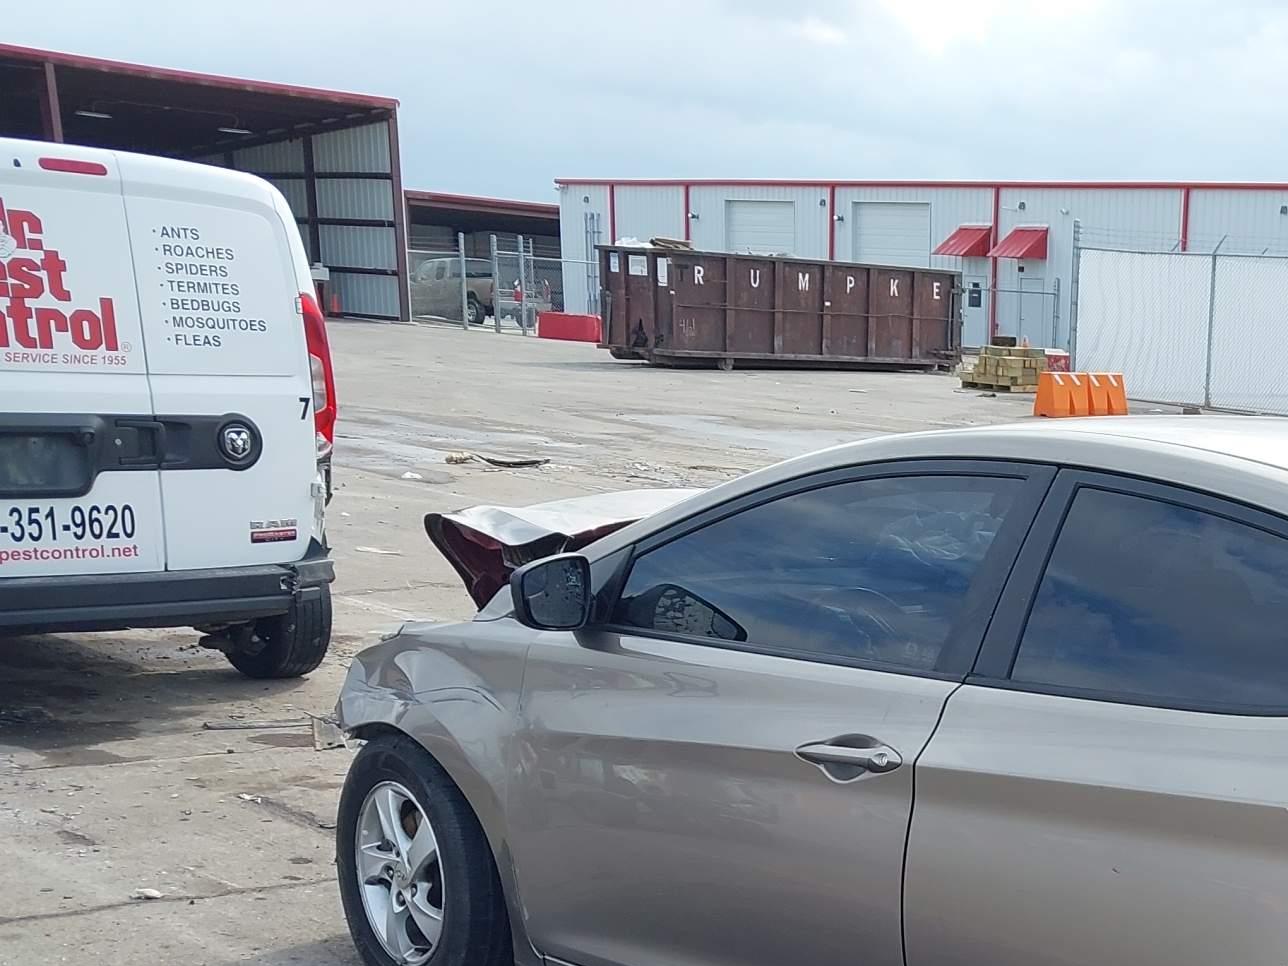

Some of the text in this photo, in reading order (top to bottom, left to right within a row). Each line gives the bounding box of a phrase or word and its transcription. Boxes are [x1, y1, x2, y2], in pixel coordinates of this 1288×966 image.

[0, 196, 43, 250] r.
[160, 226, 200, 240] ANTS
[162, 244, 234, 260] ROACHES
[0, 249, 72, 302] st
[165, 262, 228, 277] SPIDERS
[167, 280, 240, 295] TERMITES
[170, 298, 241, 313] BEDBUGS
[0, 297, 118, 351] trol
[173, 316, 267, 332] MOSQUITOES
[175, 334, 221, 347] FLEAS
[5, 352, 127, 366] SERVICE SINCE 1955
[299, 397, 310, 420] 7
[0, 544, 139, 564] pestcontrol.net
